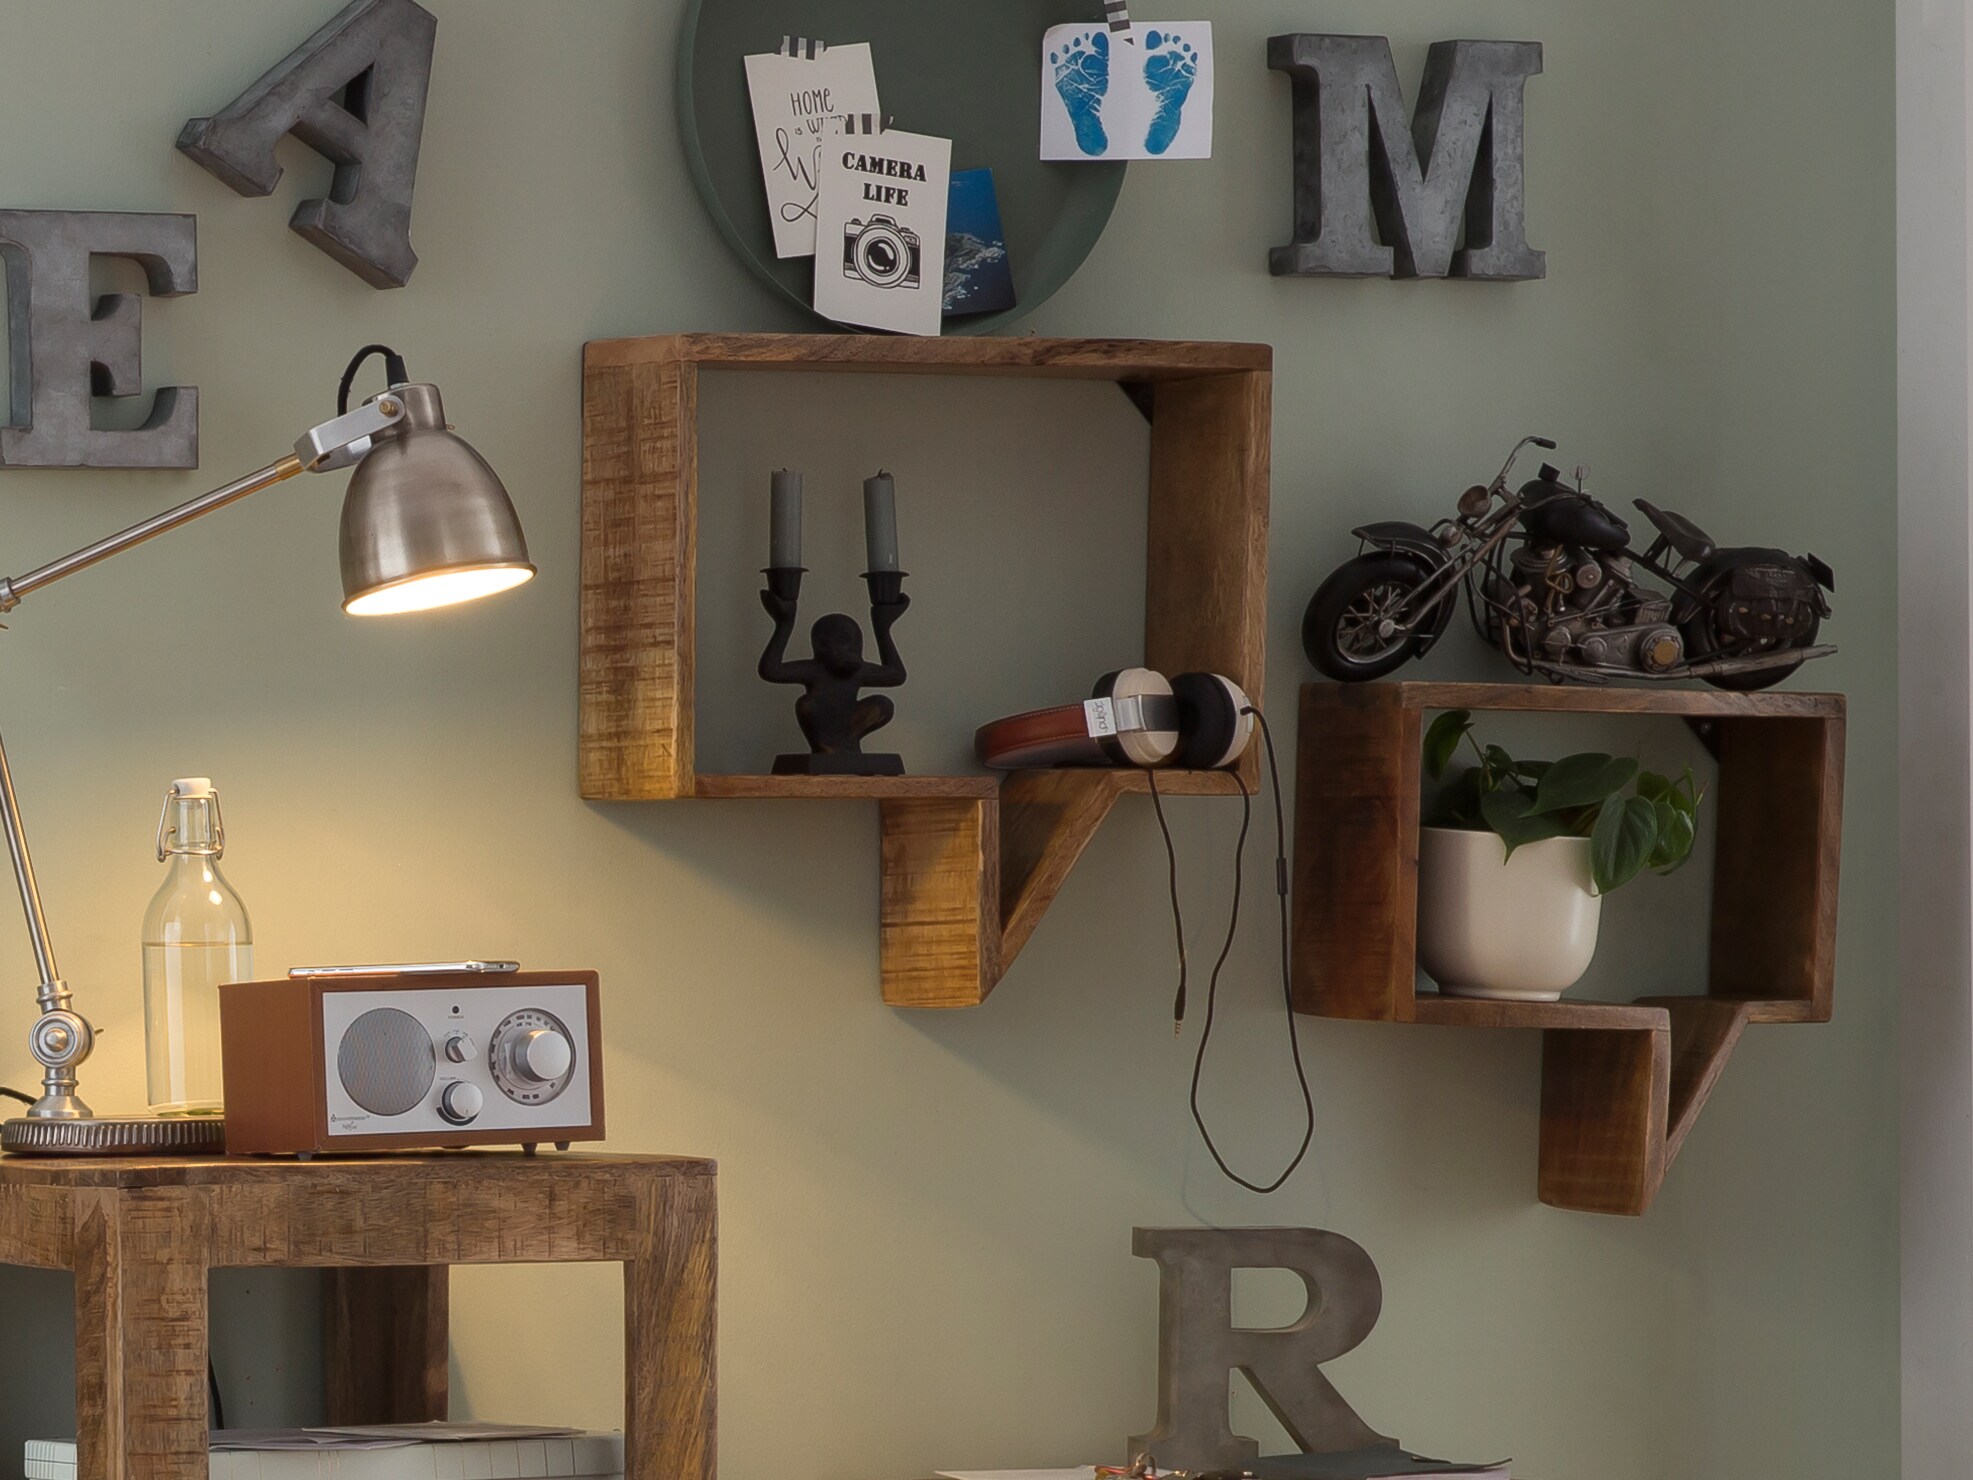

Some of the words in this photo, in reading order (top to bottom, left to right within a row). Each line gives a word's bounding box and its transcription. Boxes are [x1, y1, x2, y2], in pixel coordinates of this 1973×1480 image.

[175, 0, 437, 290] A
[842, 151, 927, 183] CAMERA
[862, 182, 909, 207] LIFE
[1267, 33, 1546, 280] M
[0, 209, 198, 470] E
[1127, 1226, 1400, 1472] R
